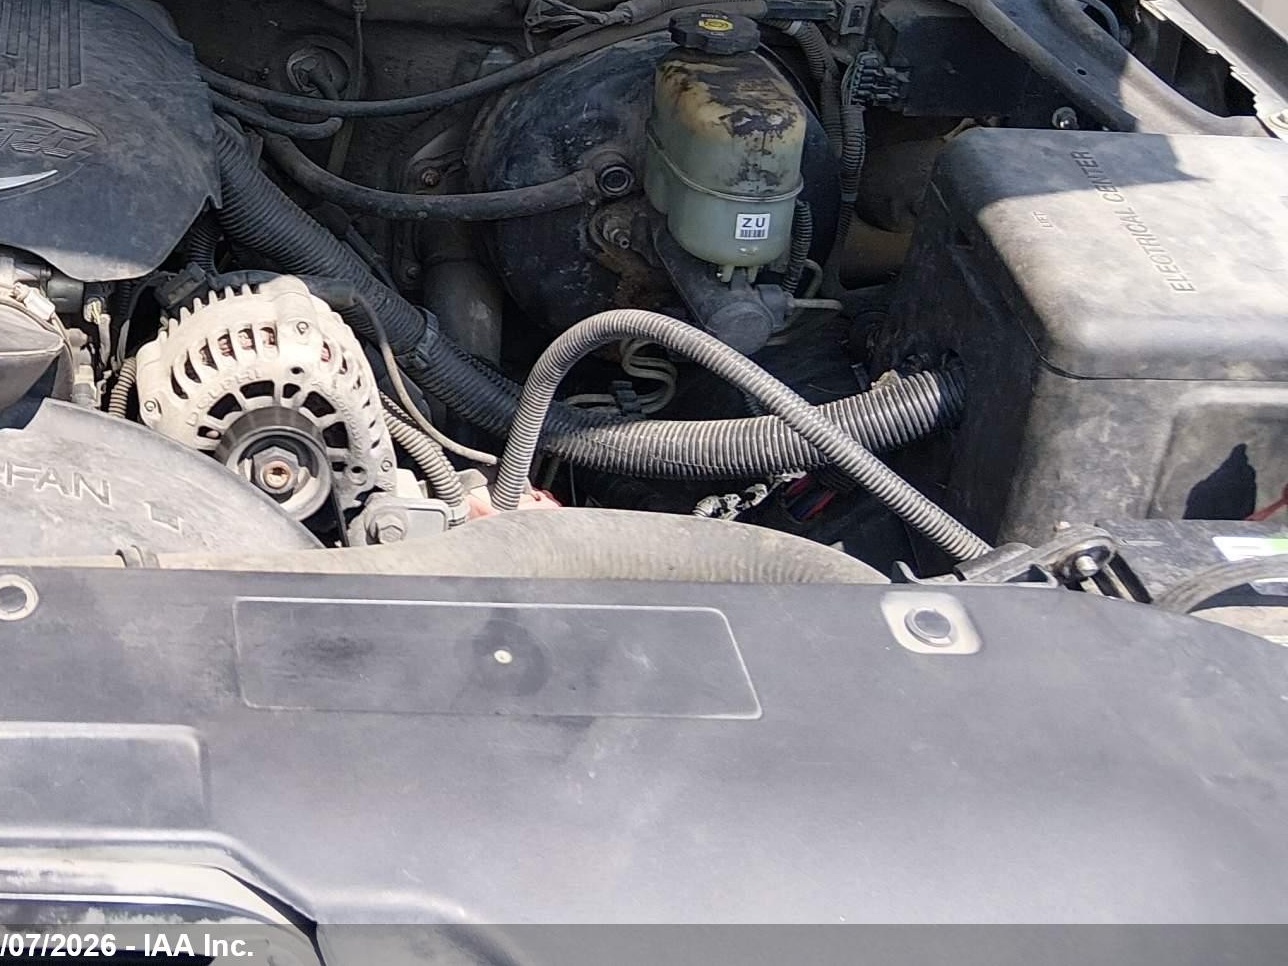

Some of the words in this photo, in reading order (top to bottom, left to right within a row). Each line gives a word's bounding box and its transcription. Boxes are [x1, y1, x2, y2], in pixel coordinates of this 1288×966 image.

[1070, 150, 1125, 203] CENTER
[1114, 207, 1196, 293] ELECTRICAL
[5, 461, 112, 506] FAN
